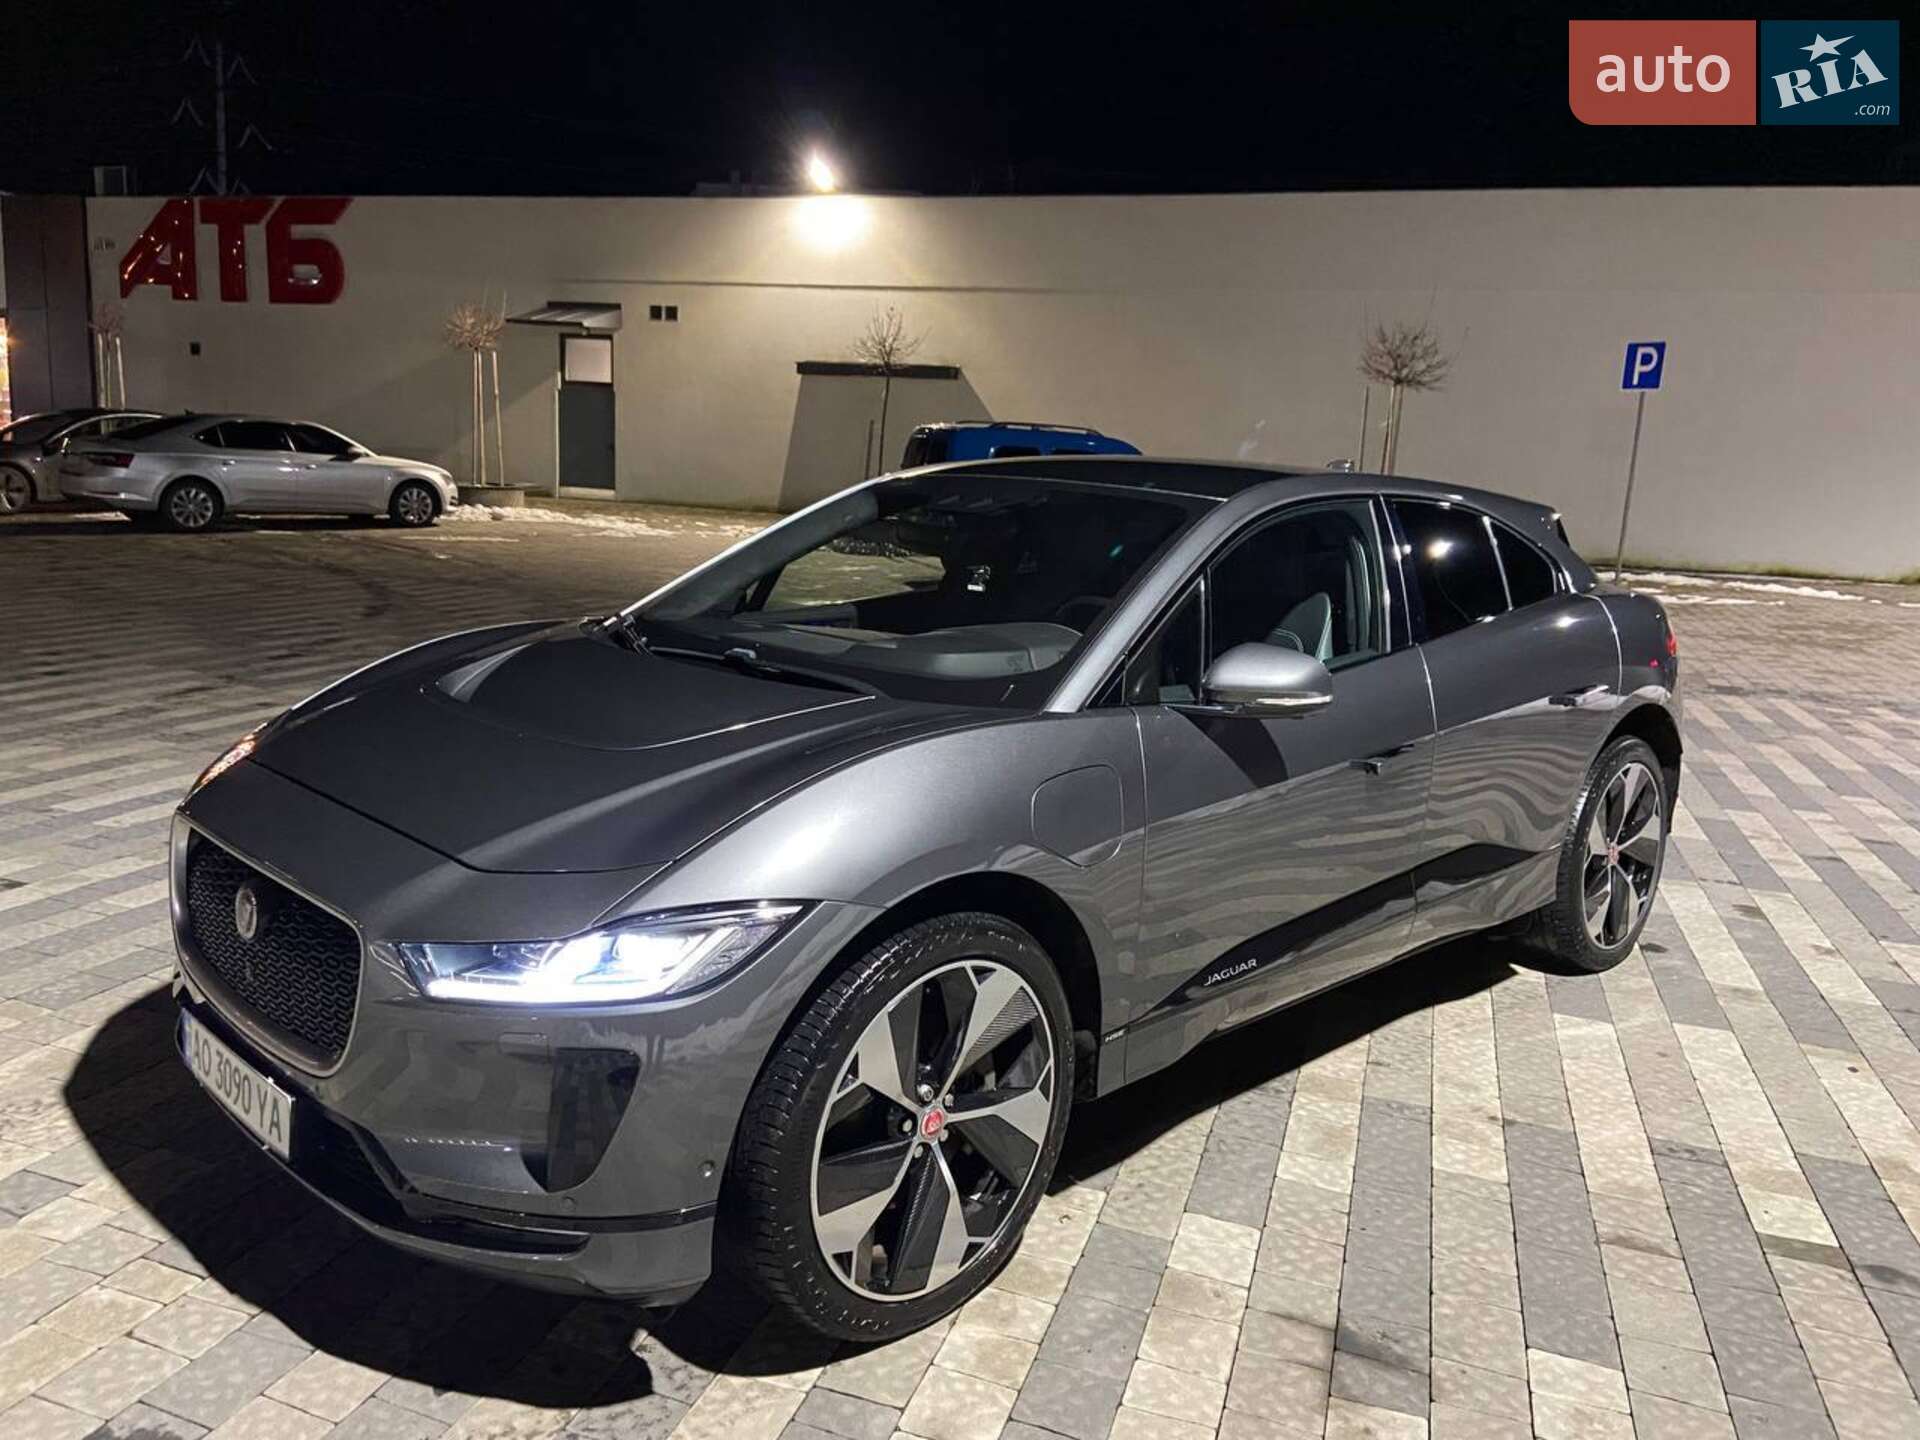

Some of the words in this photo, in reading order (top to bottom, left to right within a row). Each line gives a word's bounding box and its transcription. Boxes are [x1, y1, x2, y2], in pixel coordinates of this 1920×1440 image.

[119, 196, 354, 304] АТБ
[1632, 346, 1658, 386] P
[1203, 958, 1257, 986] JAGUAR
[193, 1029, 212, 1077] AO
[216, 1050, 251, 1115] 3090
[257, 1084, 282, 1142] YA
